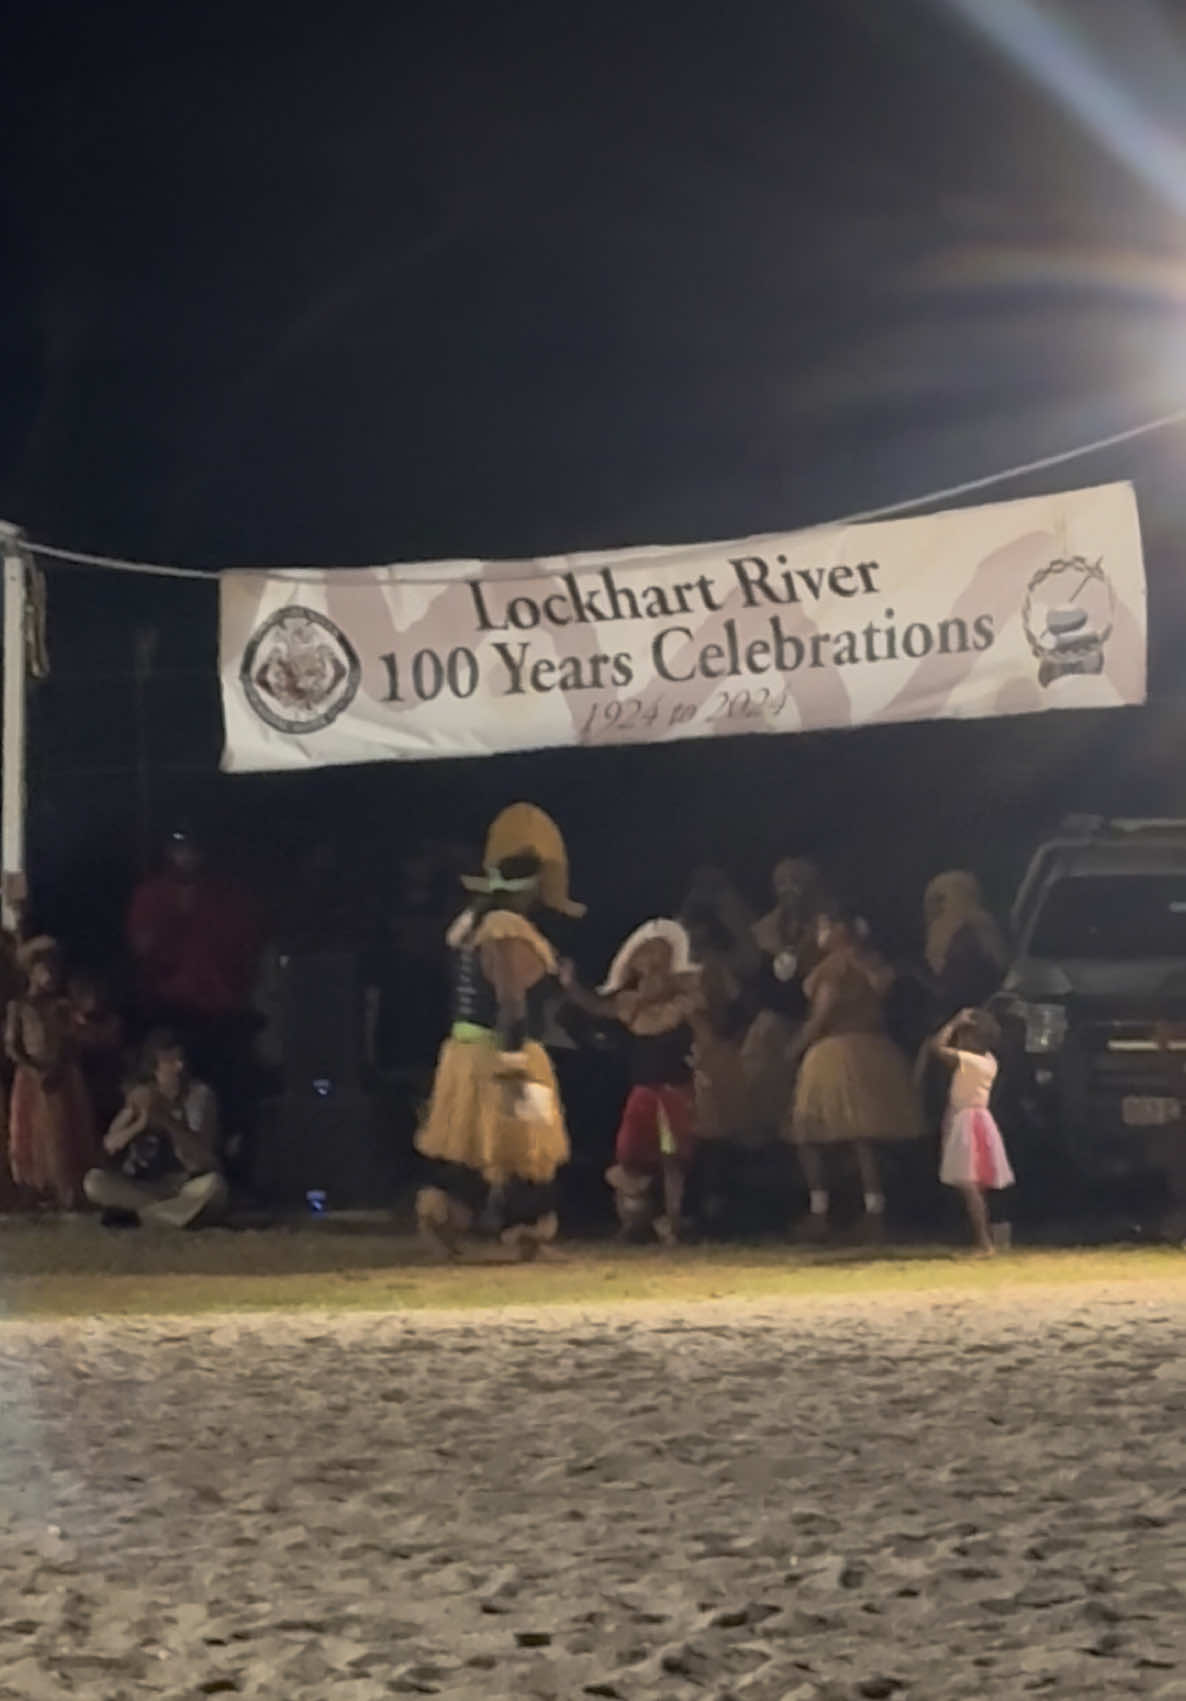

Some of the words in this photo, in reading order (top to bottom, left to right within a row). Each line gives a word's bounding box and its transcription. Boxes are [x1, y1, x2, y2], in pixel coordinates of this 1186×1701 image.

[470, 567, 724, 631] Lockhart
[728, 554, 880, 607] River
[379, 646, 480, 703] 100
[493, 641, 633, 695] Years
[651, 608, 995, 682] Celebrations
[582, 697, 661, 734] 1924
[667, 702, 699, 727] to
[705, 685, 789, 724] 2024
